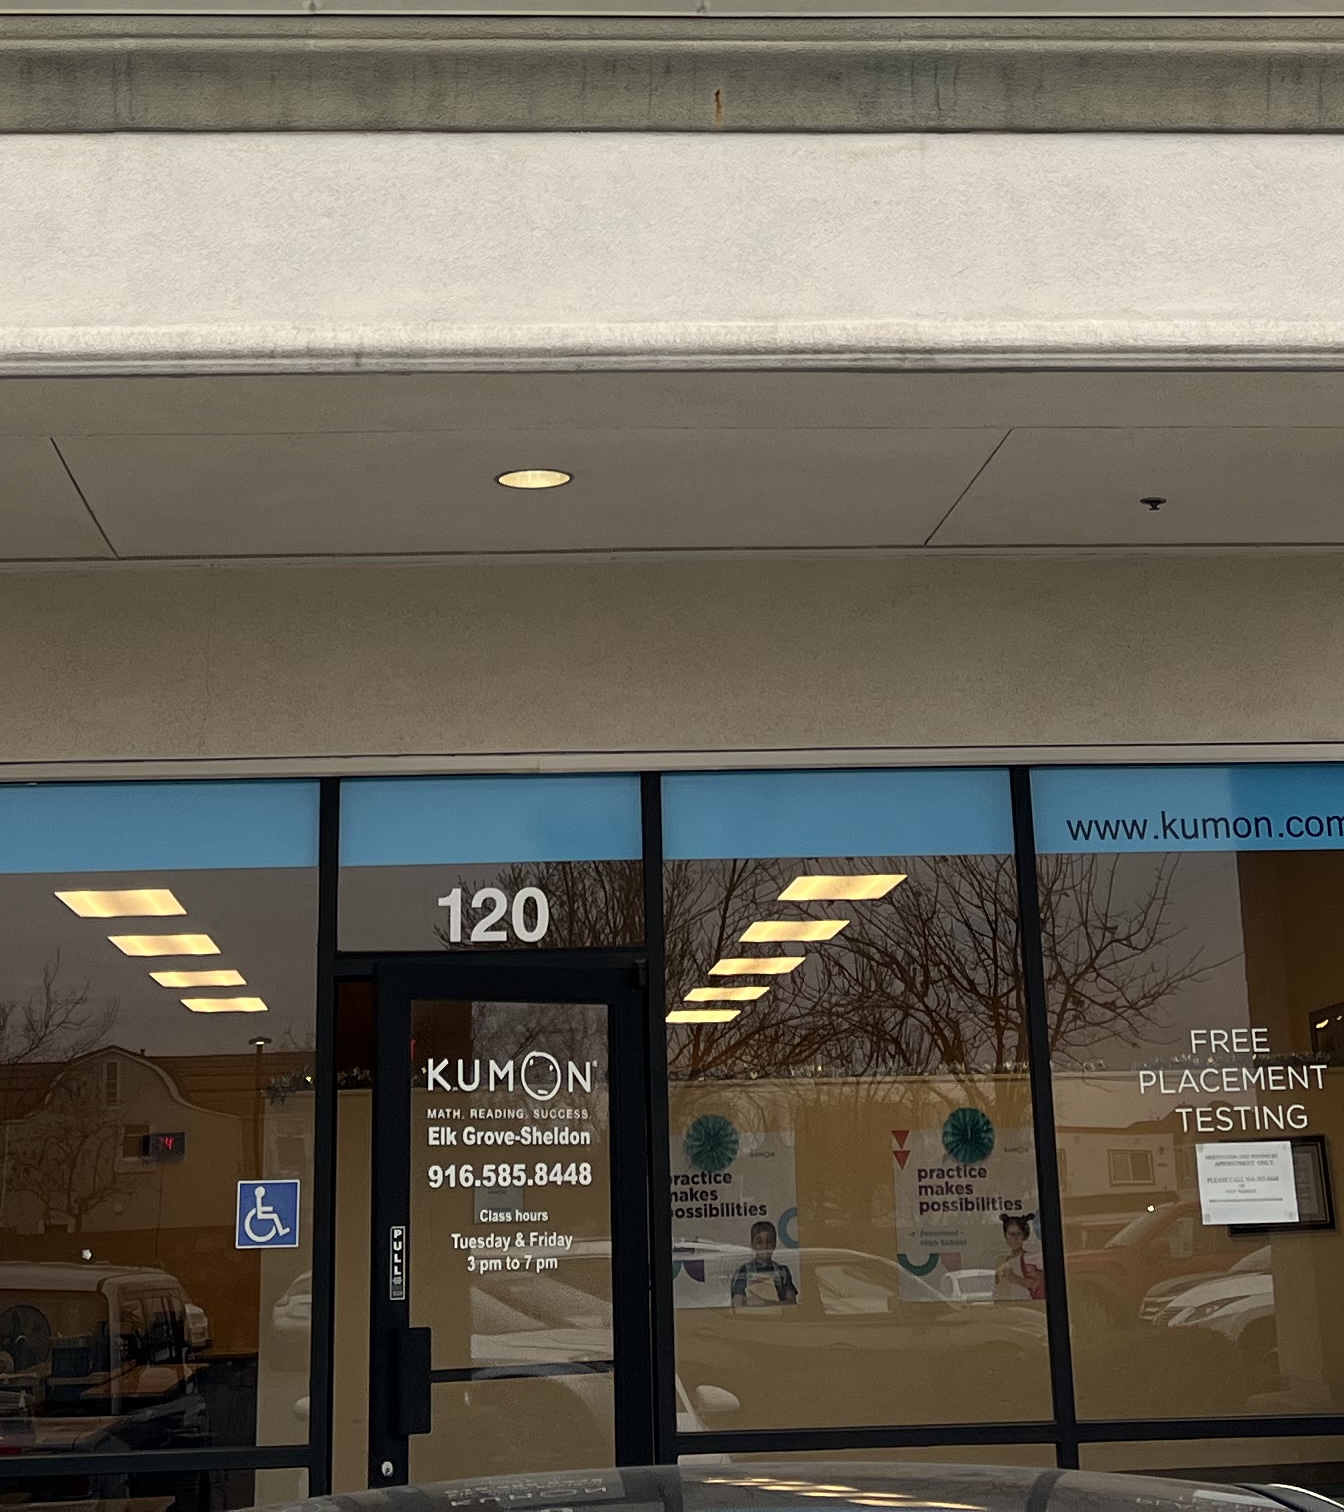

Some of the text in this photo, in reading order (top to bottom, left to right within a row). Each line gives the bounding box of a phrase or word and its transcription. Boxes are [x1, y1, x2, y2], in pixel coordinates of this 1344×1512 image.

[438, 887, 549, 942] 120
[1190, 1028, 1270, 1054] FREE
[427, 1051, 594, 1101] KUMON
[1139, 1064, 1328, 1094] PLACEMENT
[426, 1108, 465, 1120] MATH.
[470, 1108, 528, 1120] READING.
[1175, 1105, 1308, 1133] TESTING
[428, 1125, 591, 1146] Elk Grove-Sheldon
[428, 1162, 592, 1188] 916.585.8448
[669, 1171, 733, 1186] ractice
[917, 1164, 988, 1182] practice
[918, 1181, 974, 1197] makes
[671, 1202, 768, 1218] ossibilities
[919, 1196, 1023, 1215] possibilities
[479, 1209, 512, 1223] Class
[515, 1209, 549, 1222] hours
[451, 1231, 573, 1251] Tuesday & Friday
[393, 1229, 402, 1276] PULL
[467, 1255, 558, 1274] 3 pm to 7 pm
